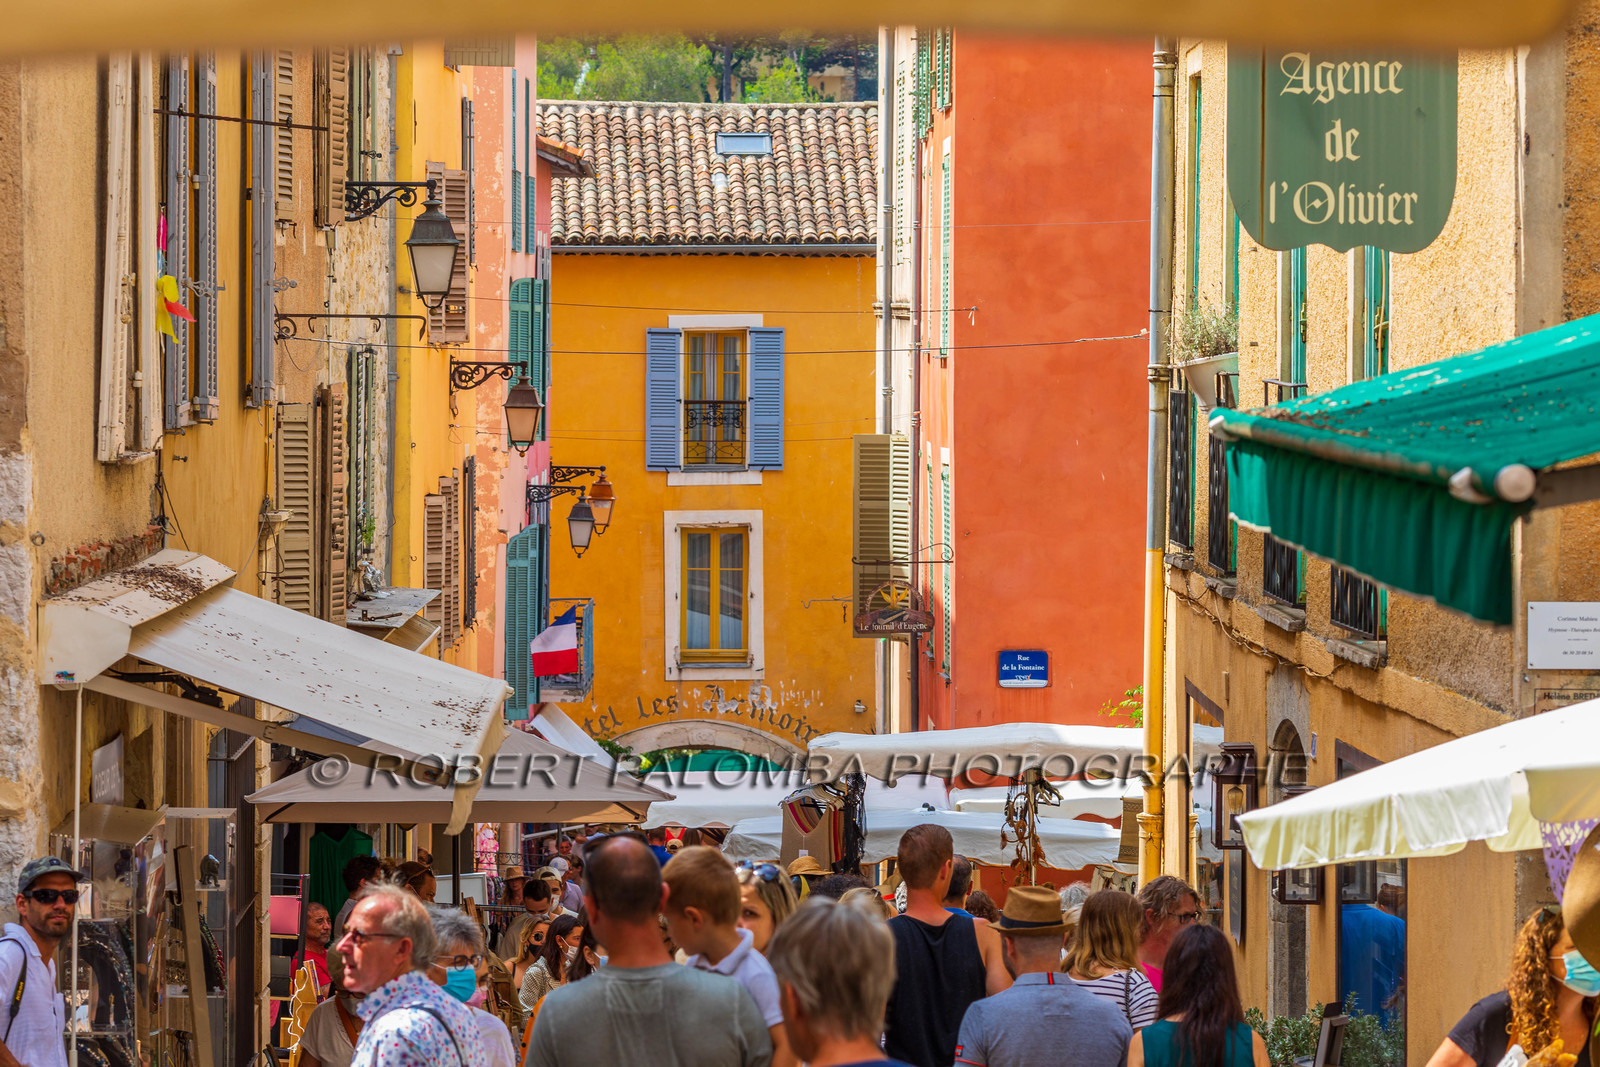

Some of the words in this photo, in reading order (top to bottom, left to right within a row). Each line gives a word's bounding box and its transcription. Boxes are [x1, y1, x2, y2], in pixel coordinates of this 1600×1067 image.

[1279, 52, 1404, 104] Agence
[1324, 118, 1361, 163] de
[1268, 180, 1418, 225] l'Olivier
[860, 622, 869, 631] Le
[872, 621, 895, 631] fournil
[1002, 663, 1010, 671] de
[1011, 663, 1017, 671] la
[1018, 663, 1045, 671] Fontaine
